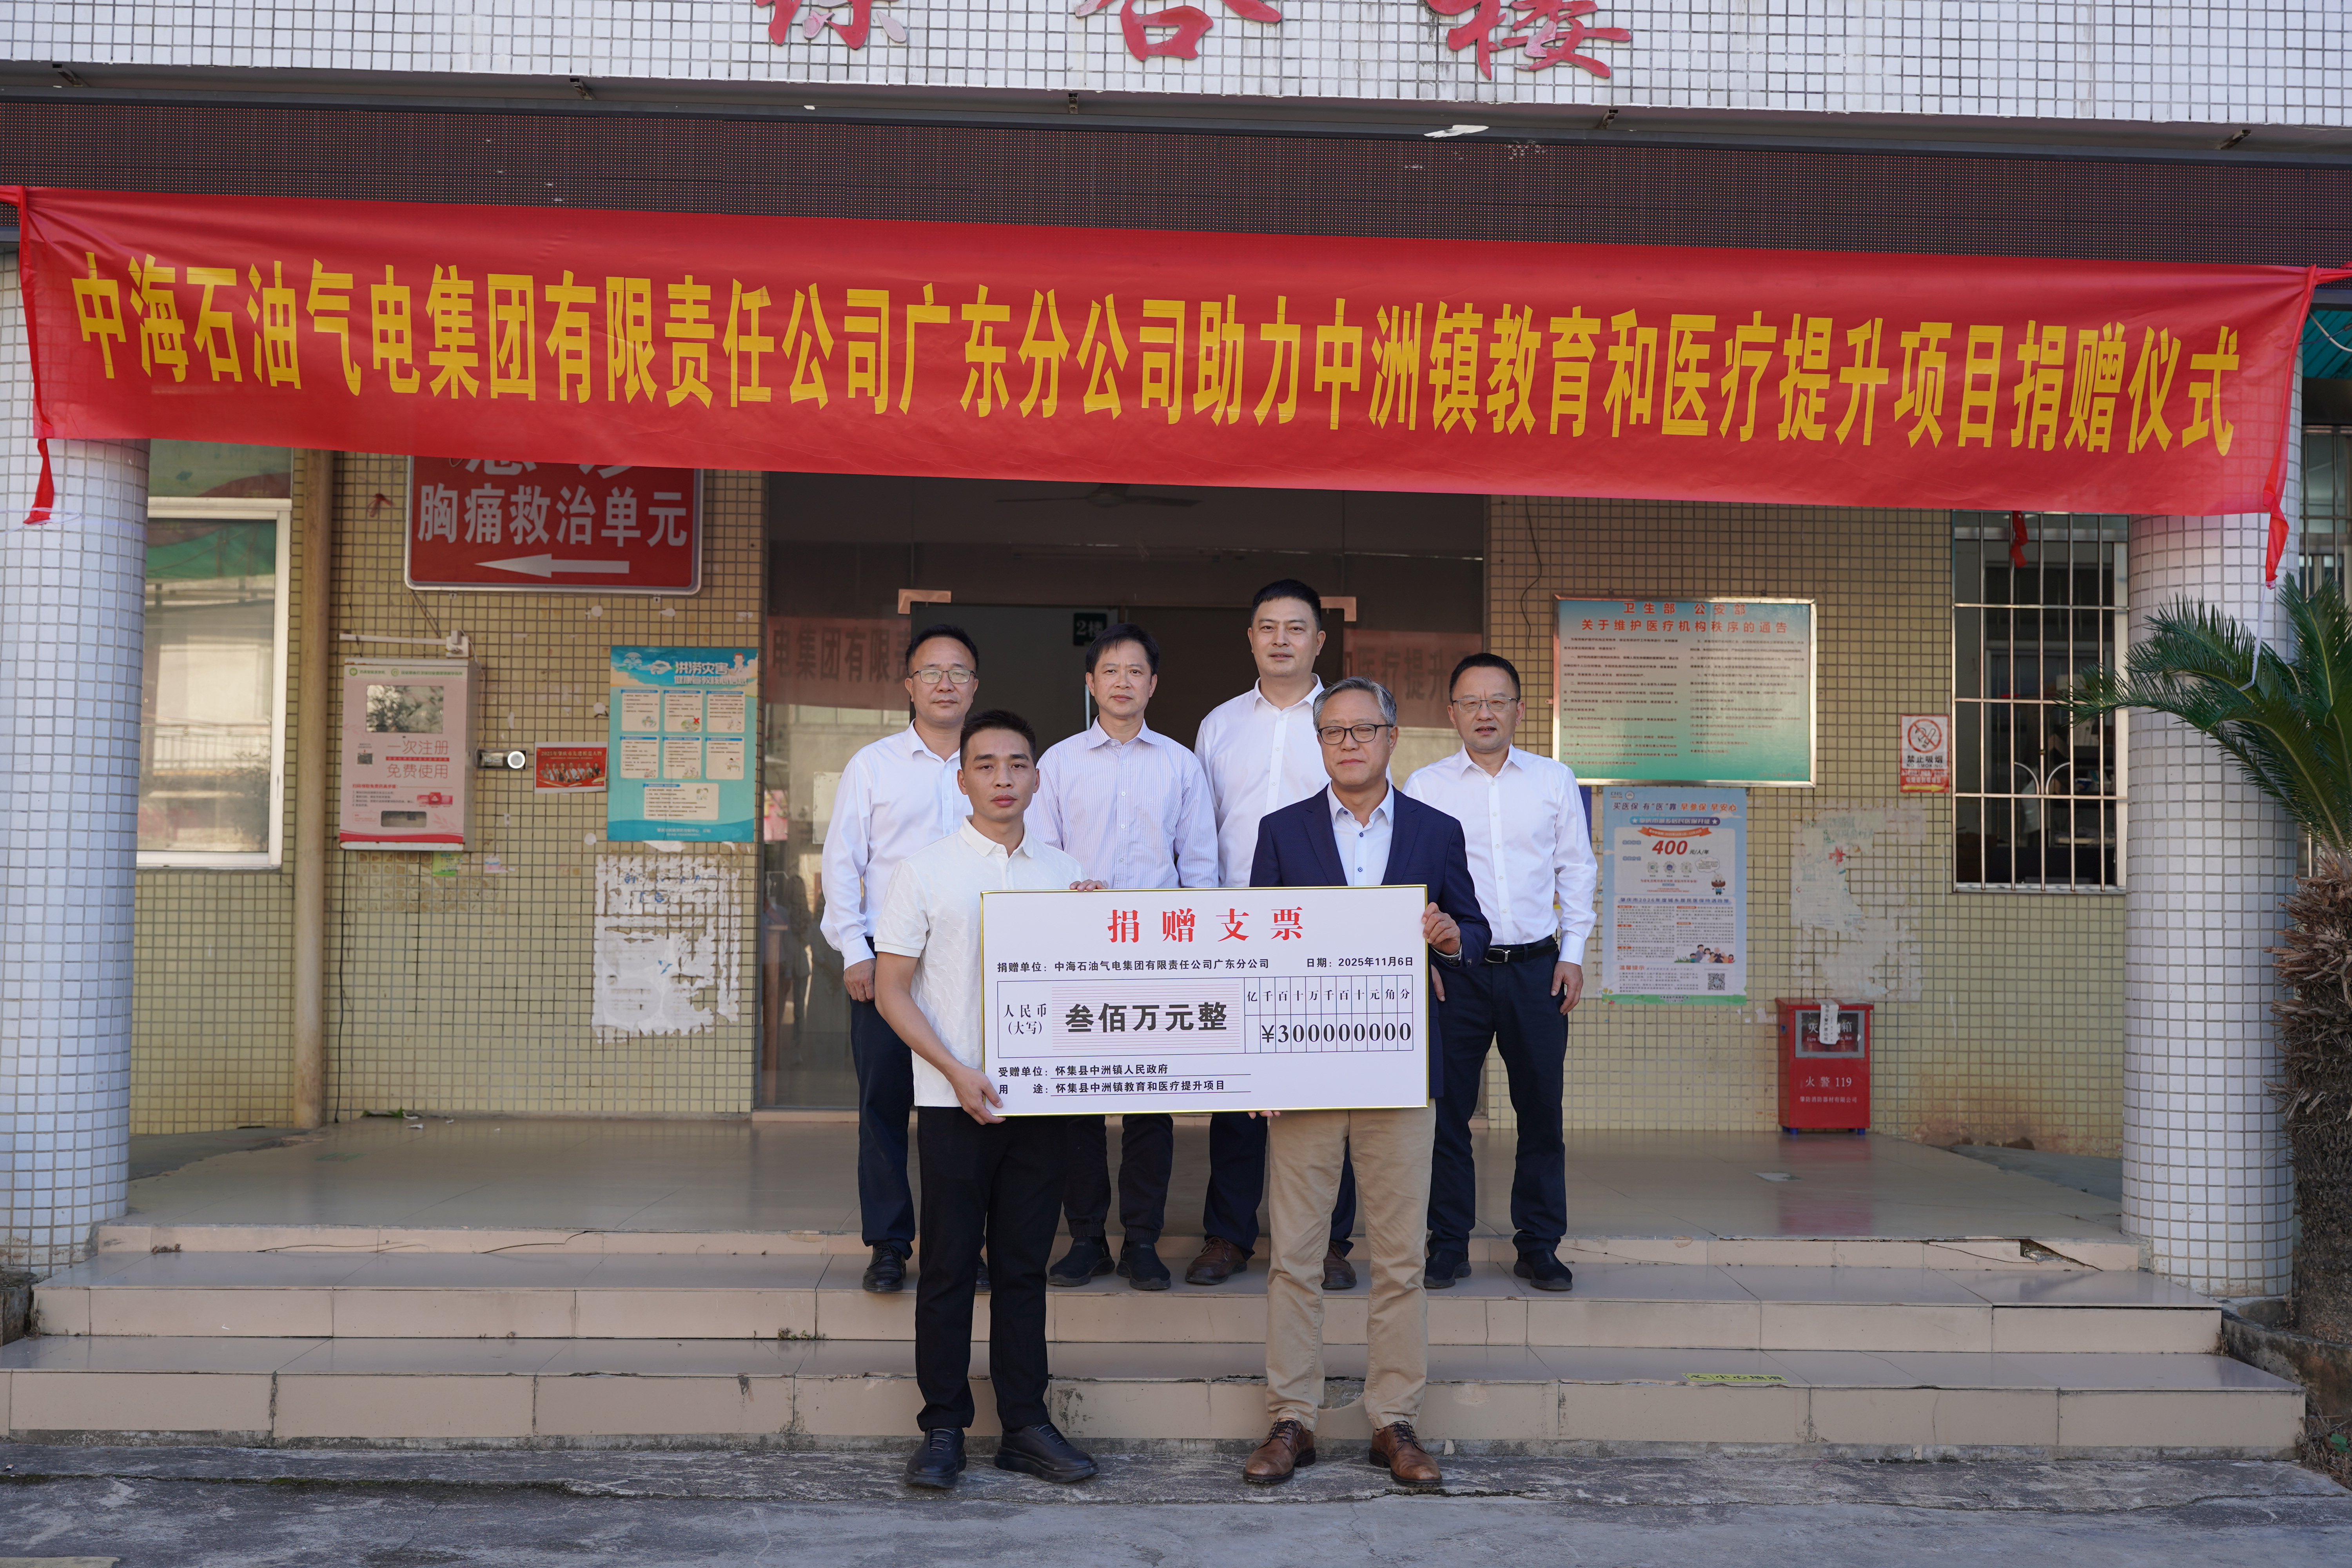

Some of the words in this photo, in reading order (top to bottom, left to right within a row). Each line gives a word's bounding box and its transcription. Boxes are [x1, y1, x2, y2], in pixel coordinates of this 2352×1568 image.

[71, 251, 2240, 456] 中海石油气电集团有限责任公司广东分公司助力中洲镇教育和医疗提升项目捐赠仪式
[417, 483, 687, 547] 胸痛救治单元
[1623, 603, 1676, 614] 卫生部
[1694, 604, 1746, 615] 公安部
[1581, 619, 1788, 633] 关于维护医疗机构秩序的通告
[675, 661, 729, 675] 洪涝灾害
[387, 740, 448, 755] 一次注册
[1907, 755, 1943, 763] 禁止吸烟
[387, 763, 448, 779] 免费使用
[1613, 802, 1639, 810] 买医保
[1680, 802, 1707, 811] 早参保
[1710, 802, 1737, 812] 早安心
[1651, 840, 1688, 855] 400
[1107, 906, 1304, 944] 捐赠支票
[997, 961, 1047, 973] 捐赠单位：
[1054, 958, 1269, 972] 中海石油气电集团有限责任公司广东分公司
[1306, 957, 1332, 968] 日期：
[1338, 956, 1413, 967] 2025年11月6日
[1003, 1002, 1047, 1018] 人民币
[1065, 1001, 1227, 1033] 叁佰万元整
[998, 1066, 1048, 1077] 受赠单位：
[1055, 1063, 1168, 1076] 怀集县中洲镇人民政府
[1056, 1080, 1225, 1093] 怀集县中洲镇教育和医疗提升项目
[1805, 1076, 1830, 1087] 火警
[1835, 1077, 1852, 1087] 119
